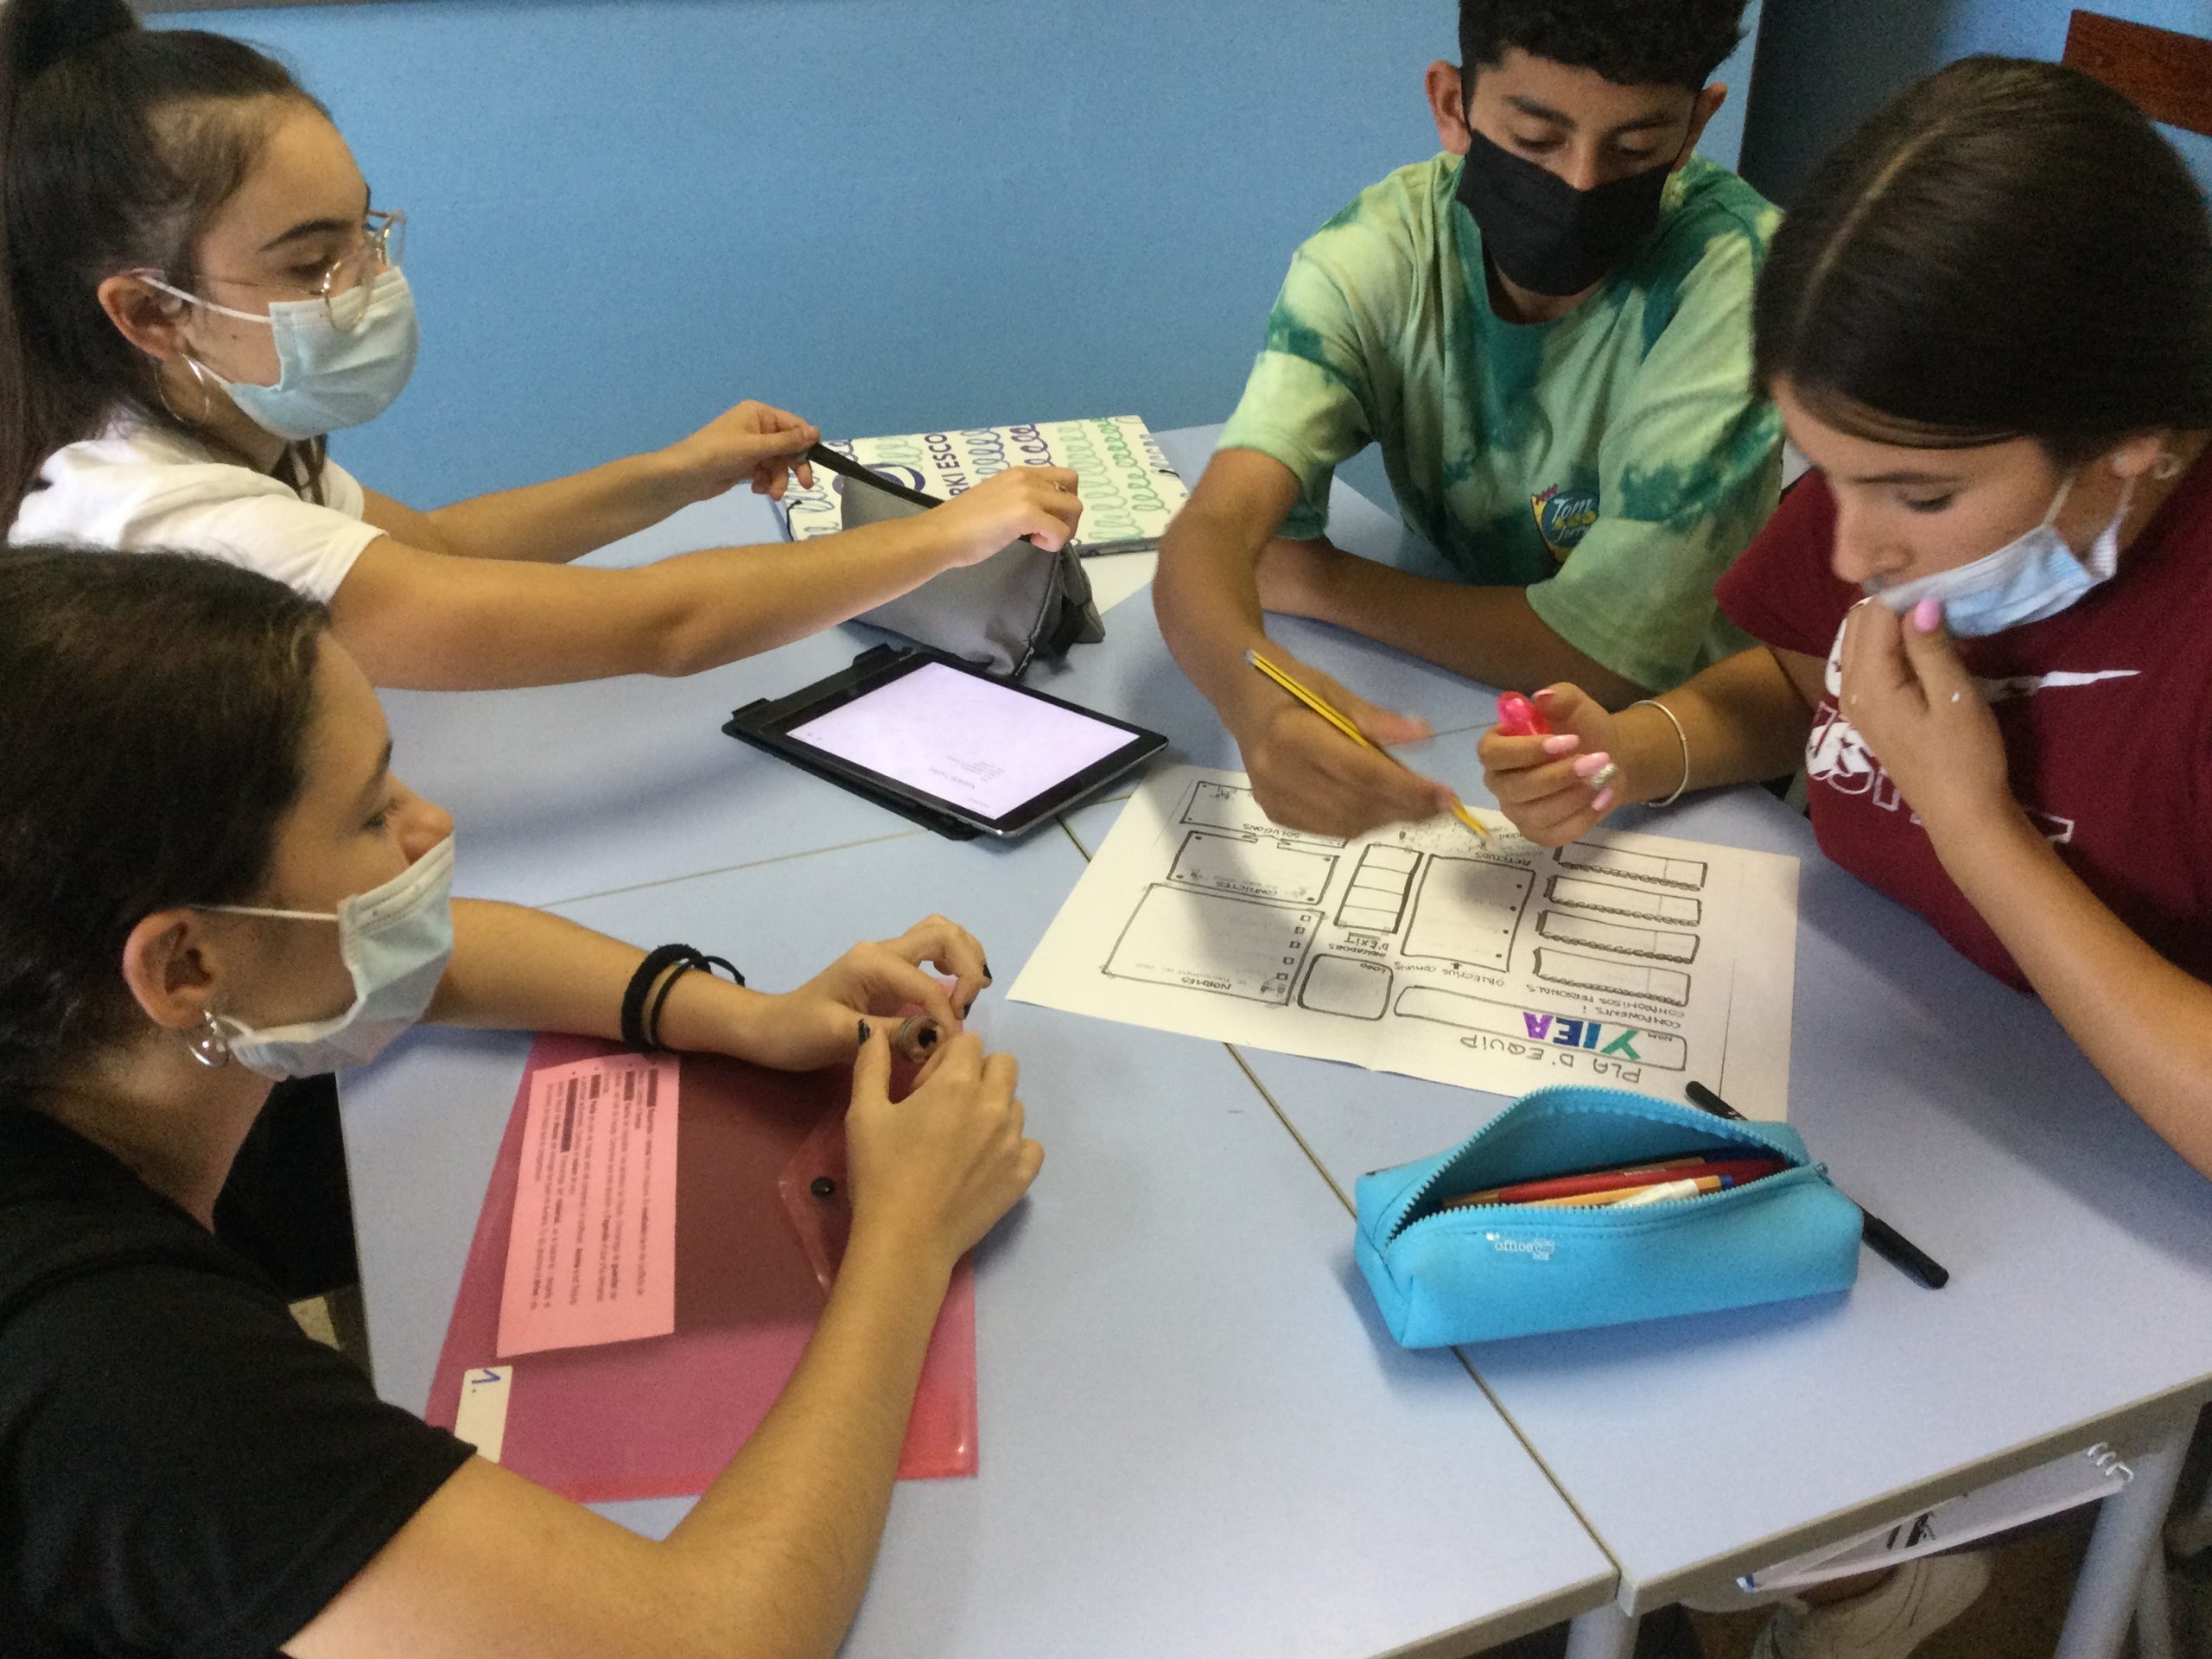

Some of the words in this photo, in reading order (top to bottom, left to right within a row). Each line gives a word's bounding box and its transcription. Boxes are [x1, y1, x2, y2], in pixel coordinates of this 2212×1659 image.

[1180, 976, 1231, 990] NORMES
[1594, 1006, 1681, 1030] COMPONENTS
[1522, 1011, 1642, 1061] YIEA
[1592, 1058, 1642, 1084] PLA
